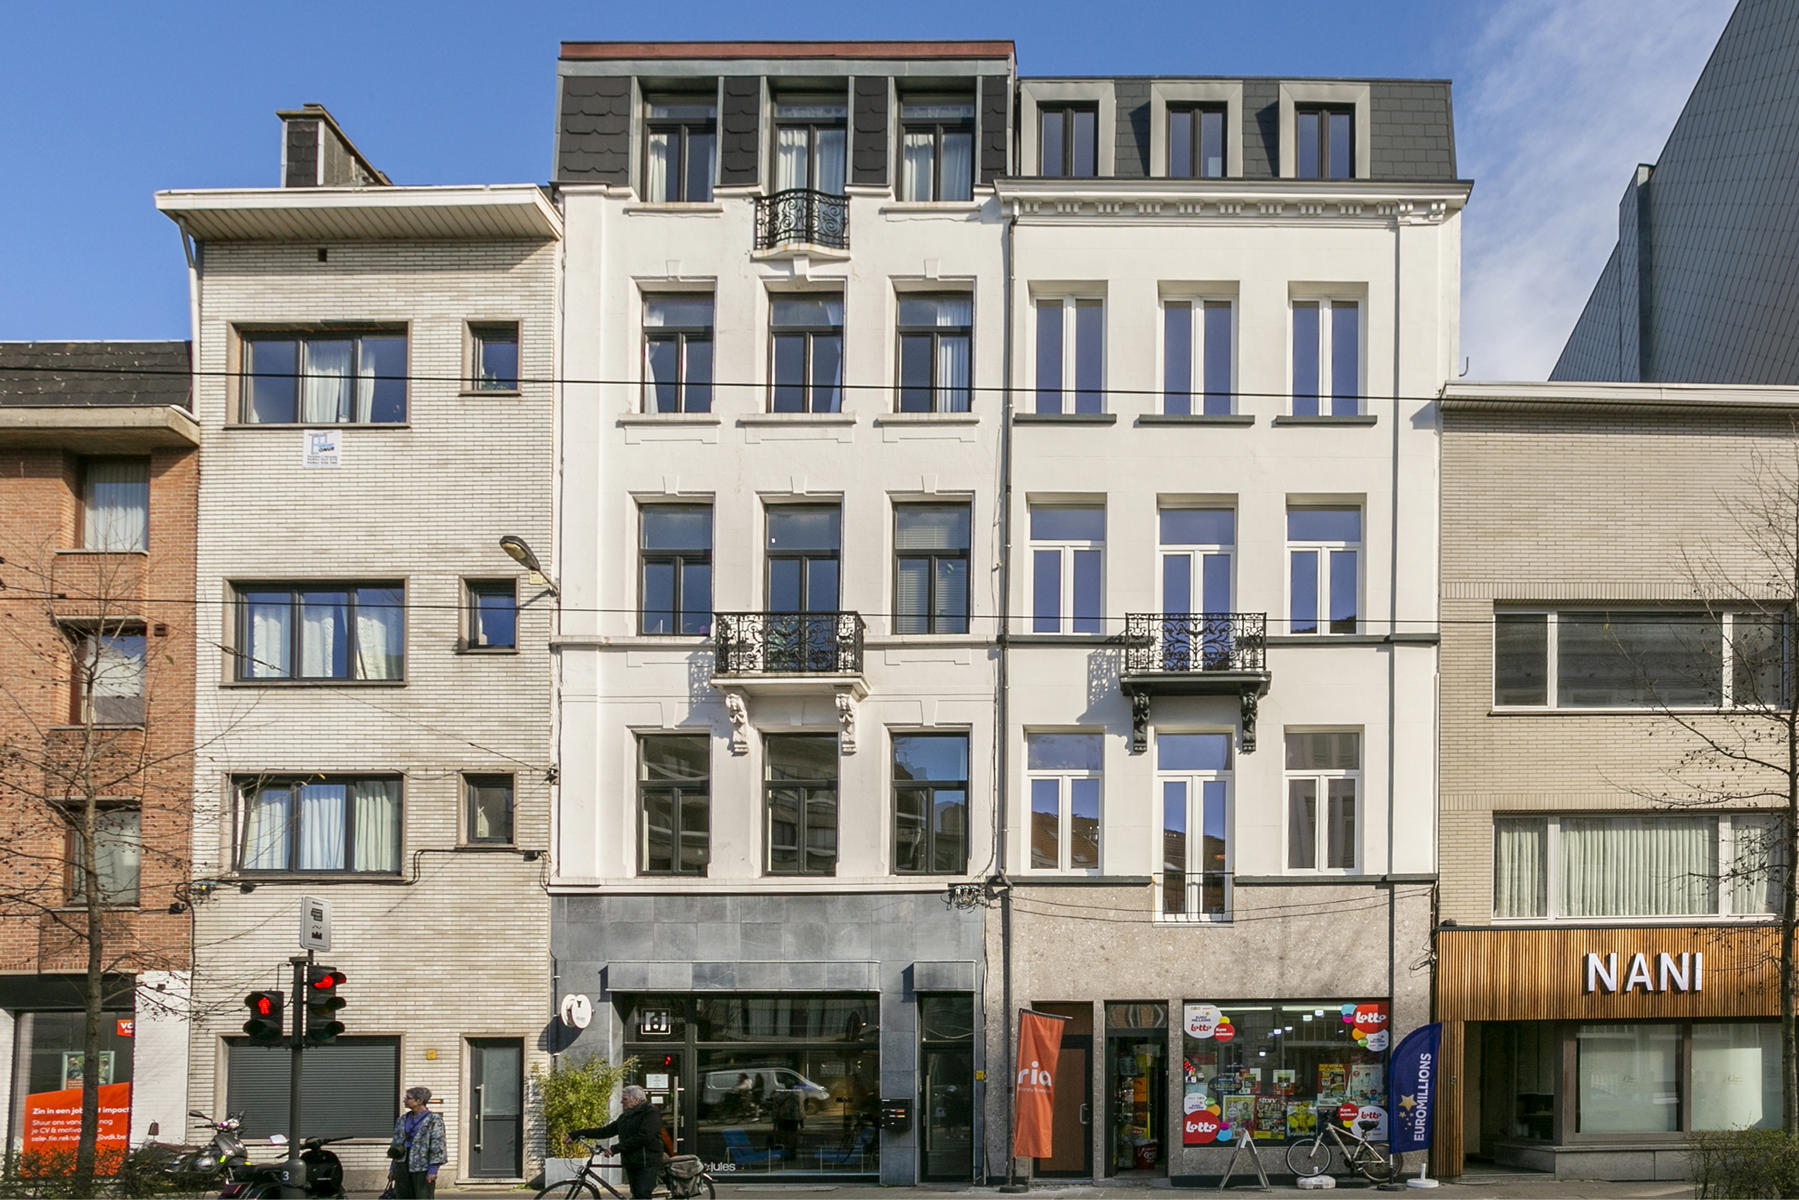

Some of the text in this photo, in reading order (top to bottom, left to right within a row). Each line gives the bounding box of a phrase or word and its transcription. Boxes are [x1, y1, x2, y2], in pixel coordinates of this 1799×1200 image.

[1587, 952, 1703, 992] NANI
[1017, 1060, 1053, 1088] ria
[32, 1107, 46, 1115] Zin
[46, 1107, 55, 1115] in
[102, 1107, 129, 1115] impact
[1413, 1053, 1432, 1142] EUROMILLIONS
[282, 1170, 290, 1181] 3
